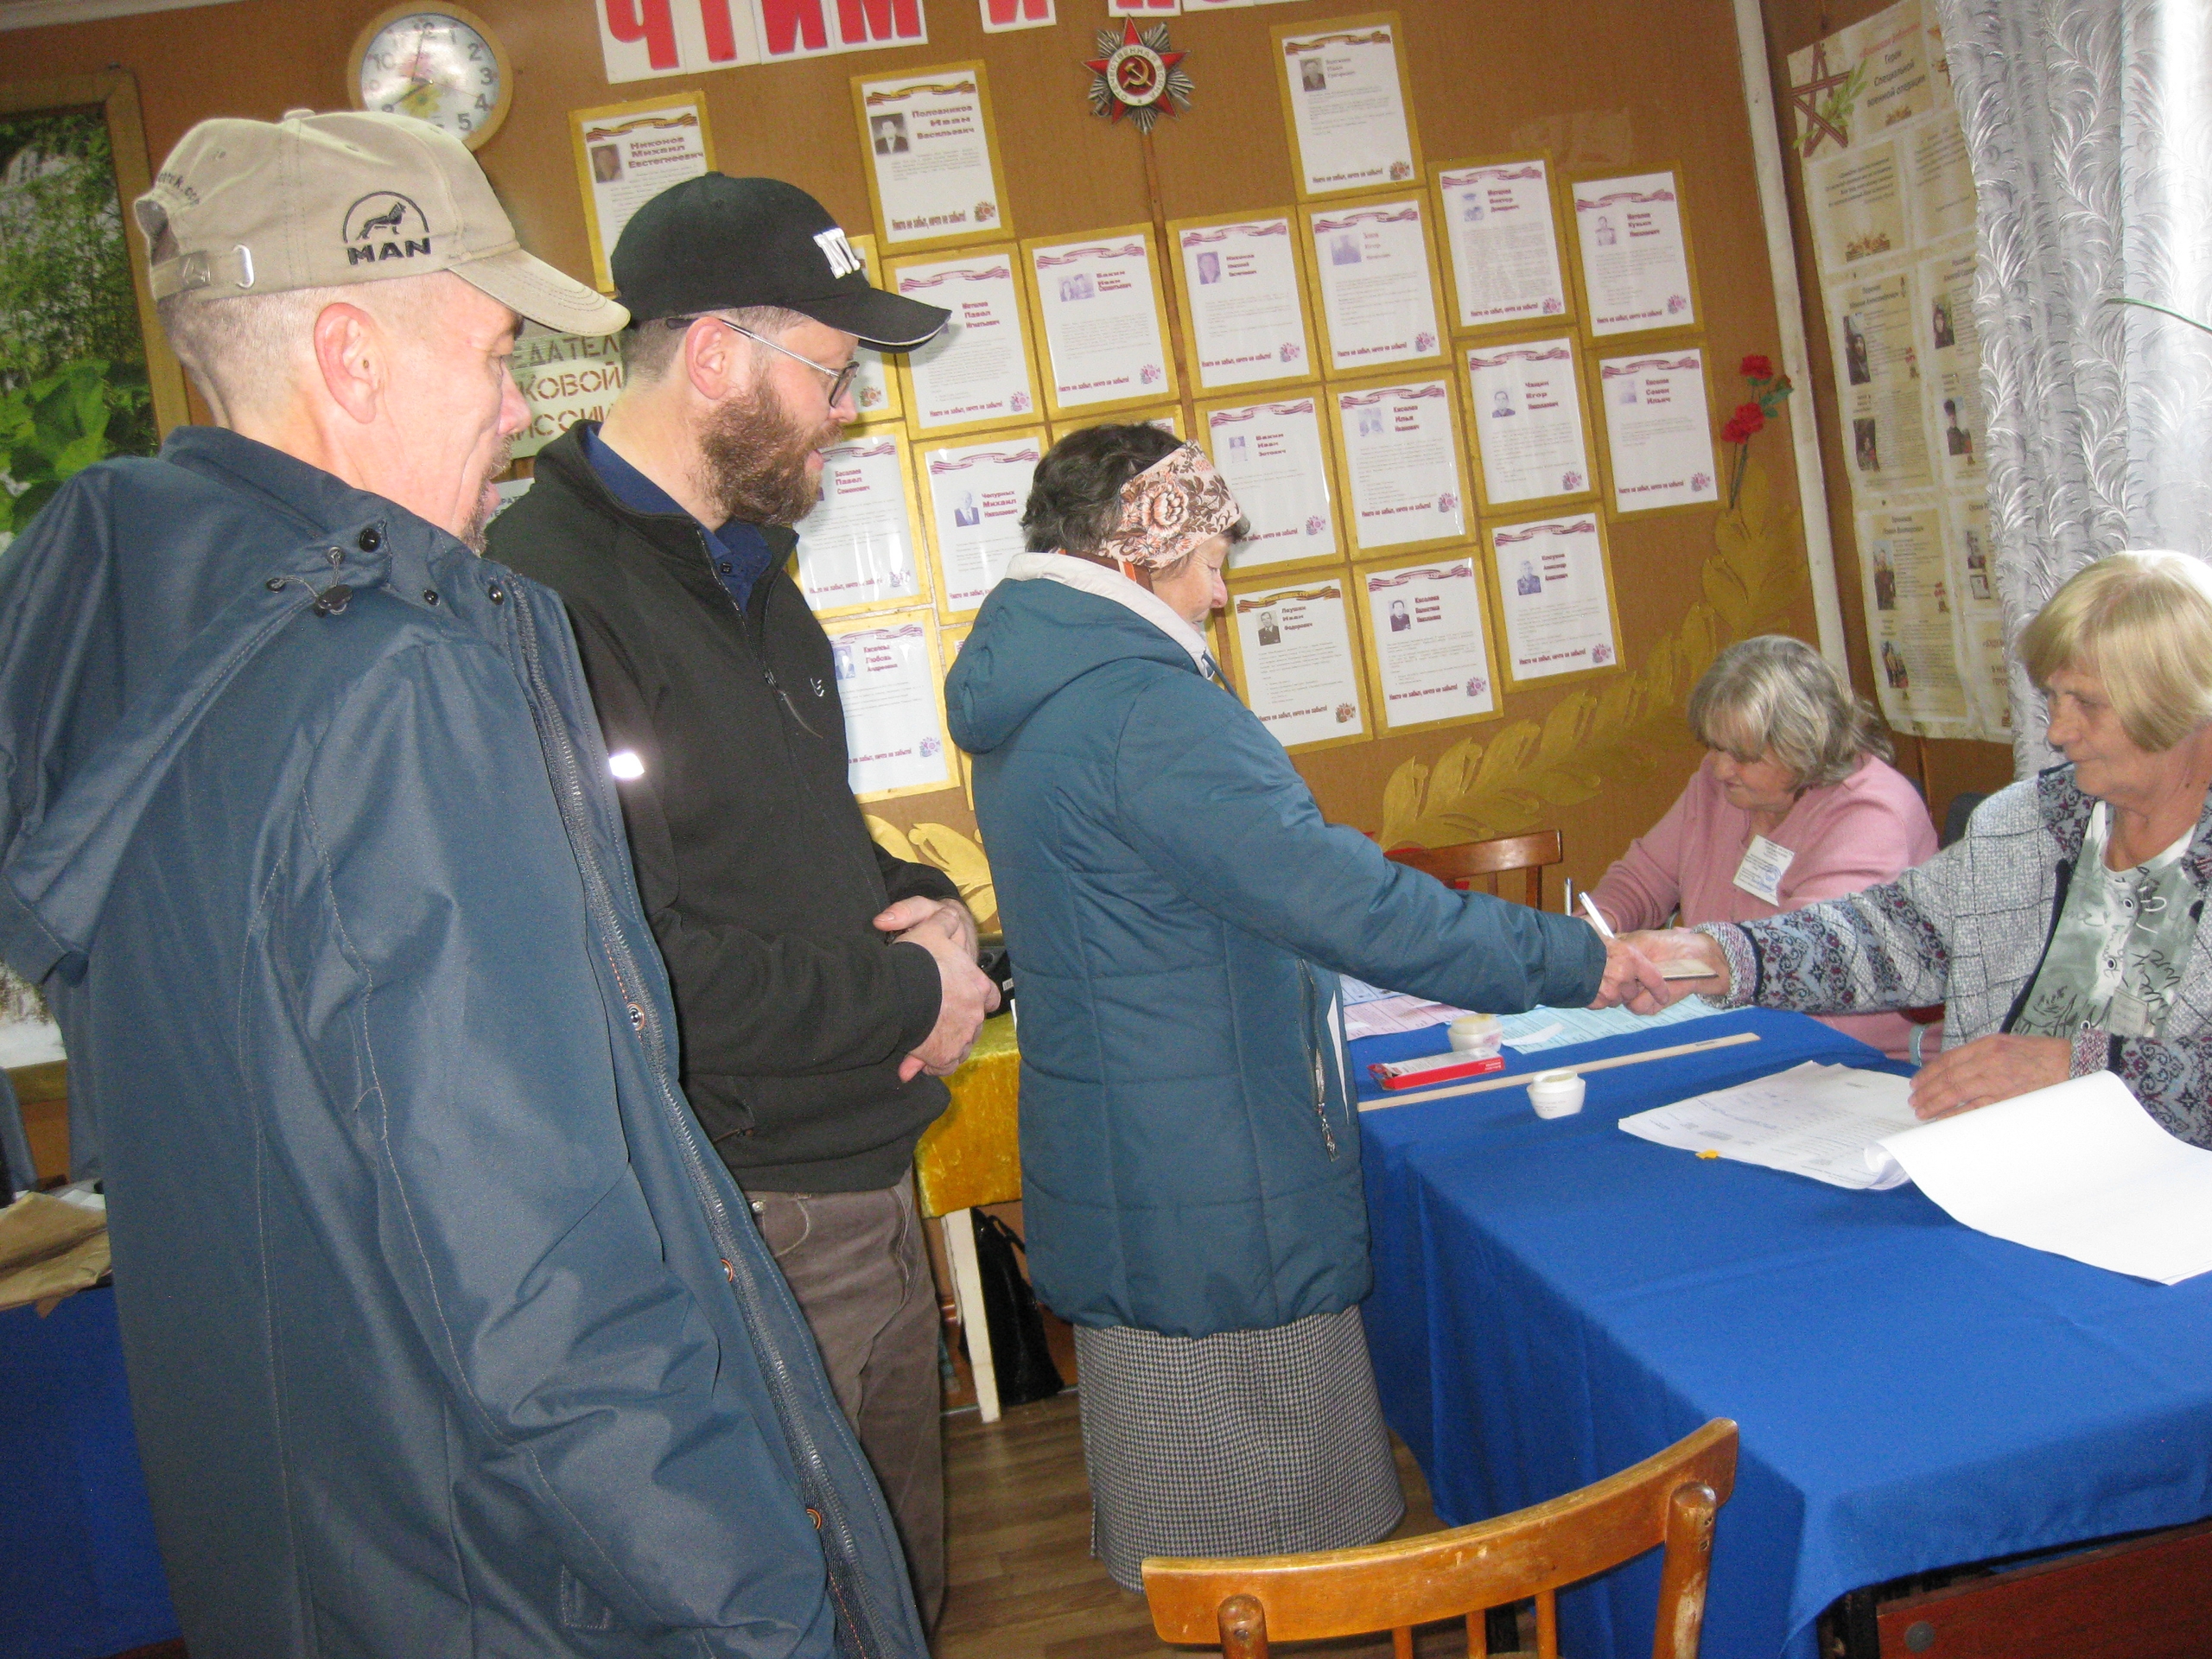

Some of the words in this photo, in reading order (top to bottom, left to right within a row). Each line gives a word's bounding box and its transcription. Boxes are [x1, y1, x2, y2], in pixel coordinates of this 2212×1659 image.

[467, 43, 482, 62] 2
[480, 67, 494, 86] 3
[474, 92, 489, 111] 4
[457, 112, 473, 130] 5
[930, 117, 970, 127] Иван
[917, 127, 975, 140] Васильевич
[630, 137, 684, 149] Никонов
[632, 145, 685, 158] Михаил
[347, 238, 431, 264] MAN
[836, 477, 862, 486] Павел
[982, 499, 1016, 508] Михаил
